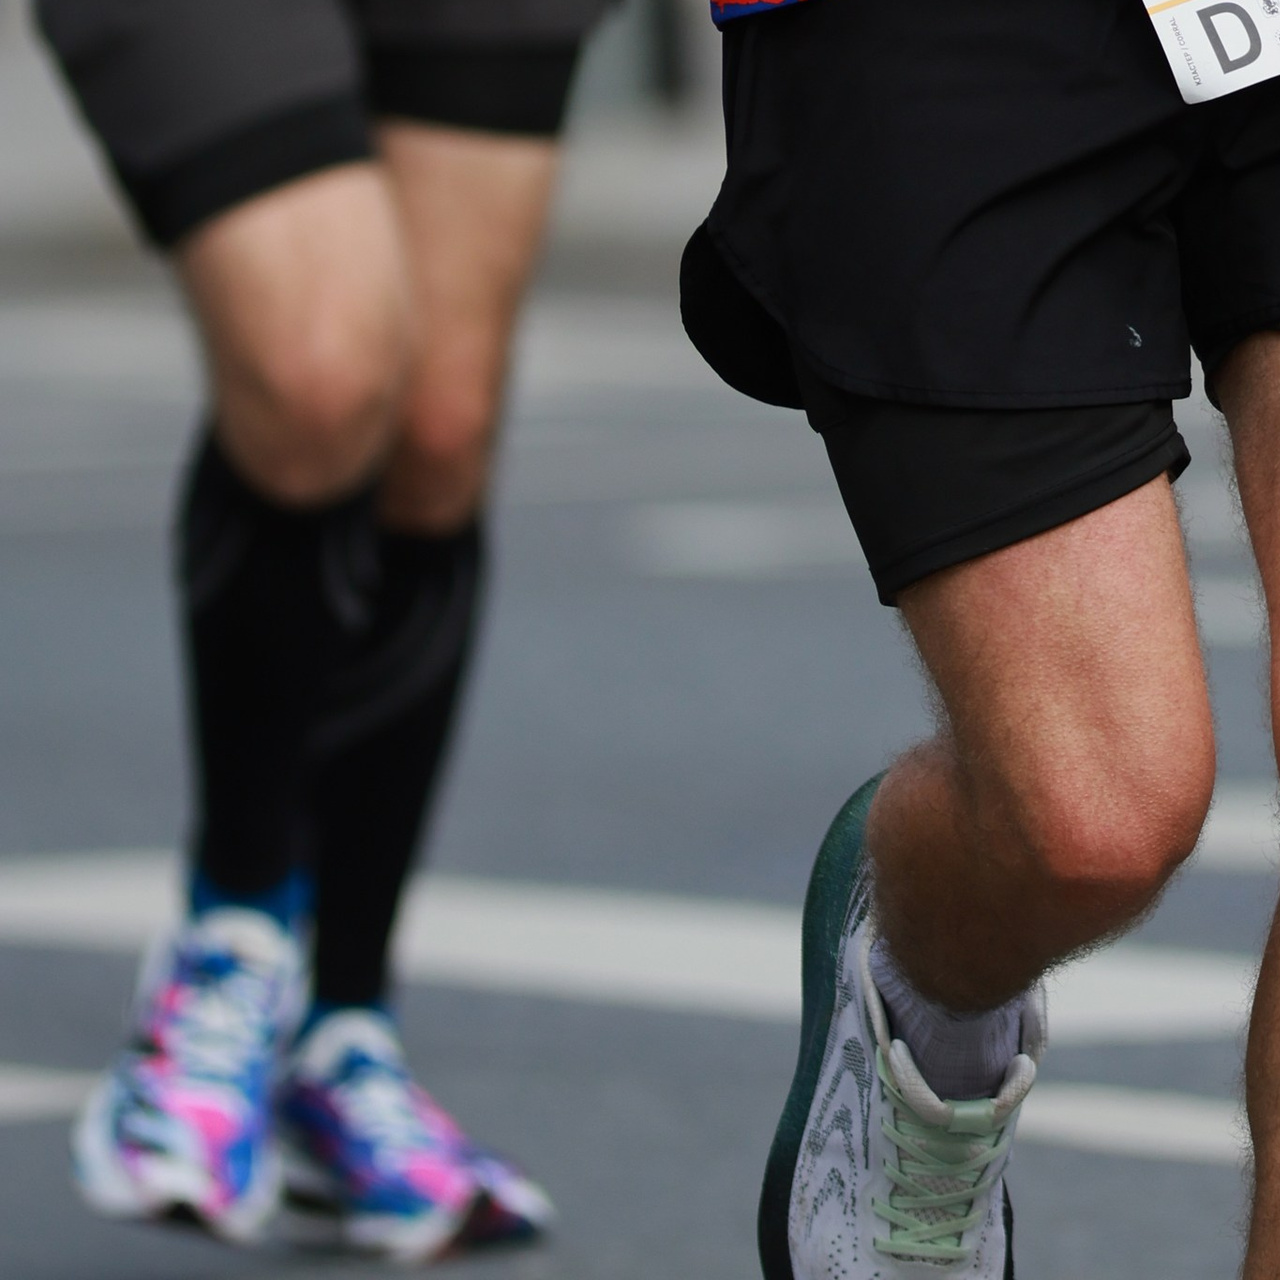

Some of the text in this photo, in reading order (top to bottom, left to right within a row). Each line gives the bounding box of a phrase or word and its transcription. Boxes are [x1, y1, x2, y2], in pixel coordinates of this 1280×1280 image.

[1169, 16, 1186, 46] CORRAL
[1196, 1, 1263, 76] D
[1183, 51, 1202, 87] КЛАСТЕР
